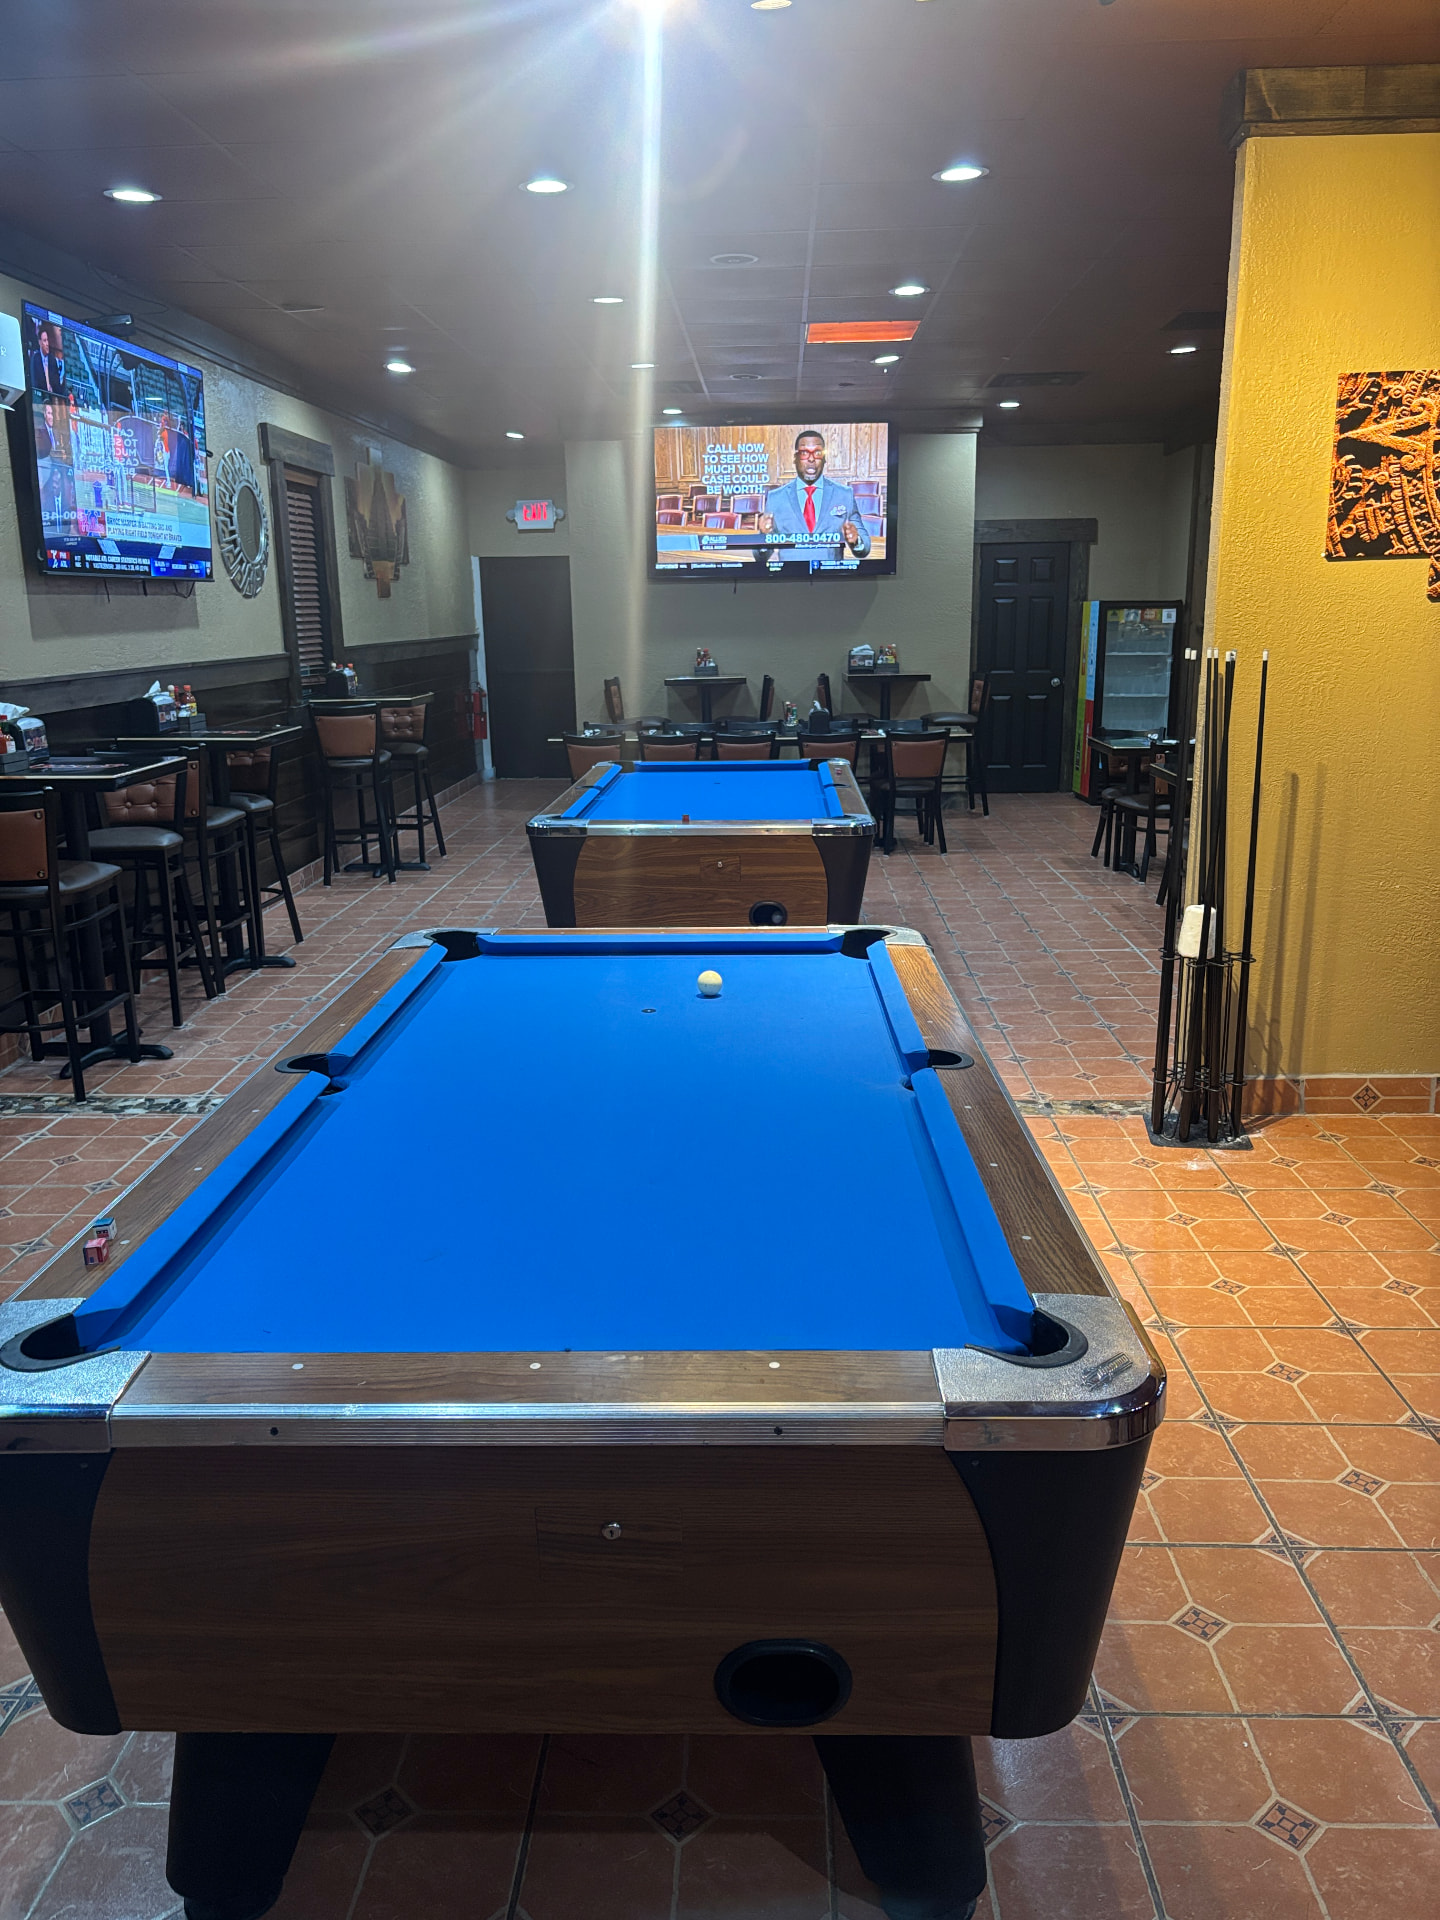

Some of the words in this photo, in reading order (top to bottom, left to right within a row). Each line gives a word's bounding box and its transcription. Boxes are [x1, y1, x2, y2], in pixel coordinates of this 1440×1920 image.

[706, 443, 736, 454] CALL
[737, 443, 765, 453] NOW
[702, 454, 719, 464] TO
[719, 454, 741, 464] SEE
[742, 453, 769, 463] HOW
[704, 464, 736, 474] MUCH
[736, 463, 768, 474] YOUR
[701, 475, 732, 485] CASE
[732, 474, 770, 484] COULD
[706, 485, 722, 495] BE
[722, 484, 766, 495] WORTH.
[523, 502, 548, 521] EXIT
[764, 533, 841, 544] 800-480-0470
